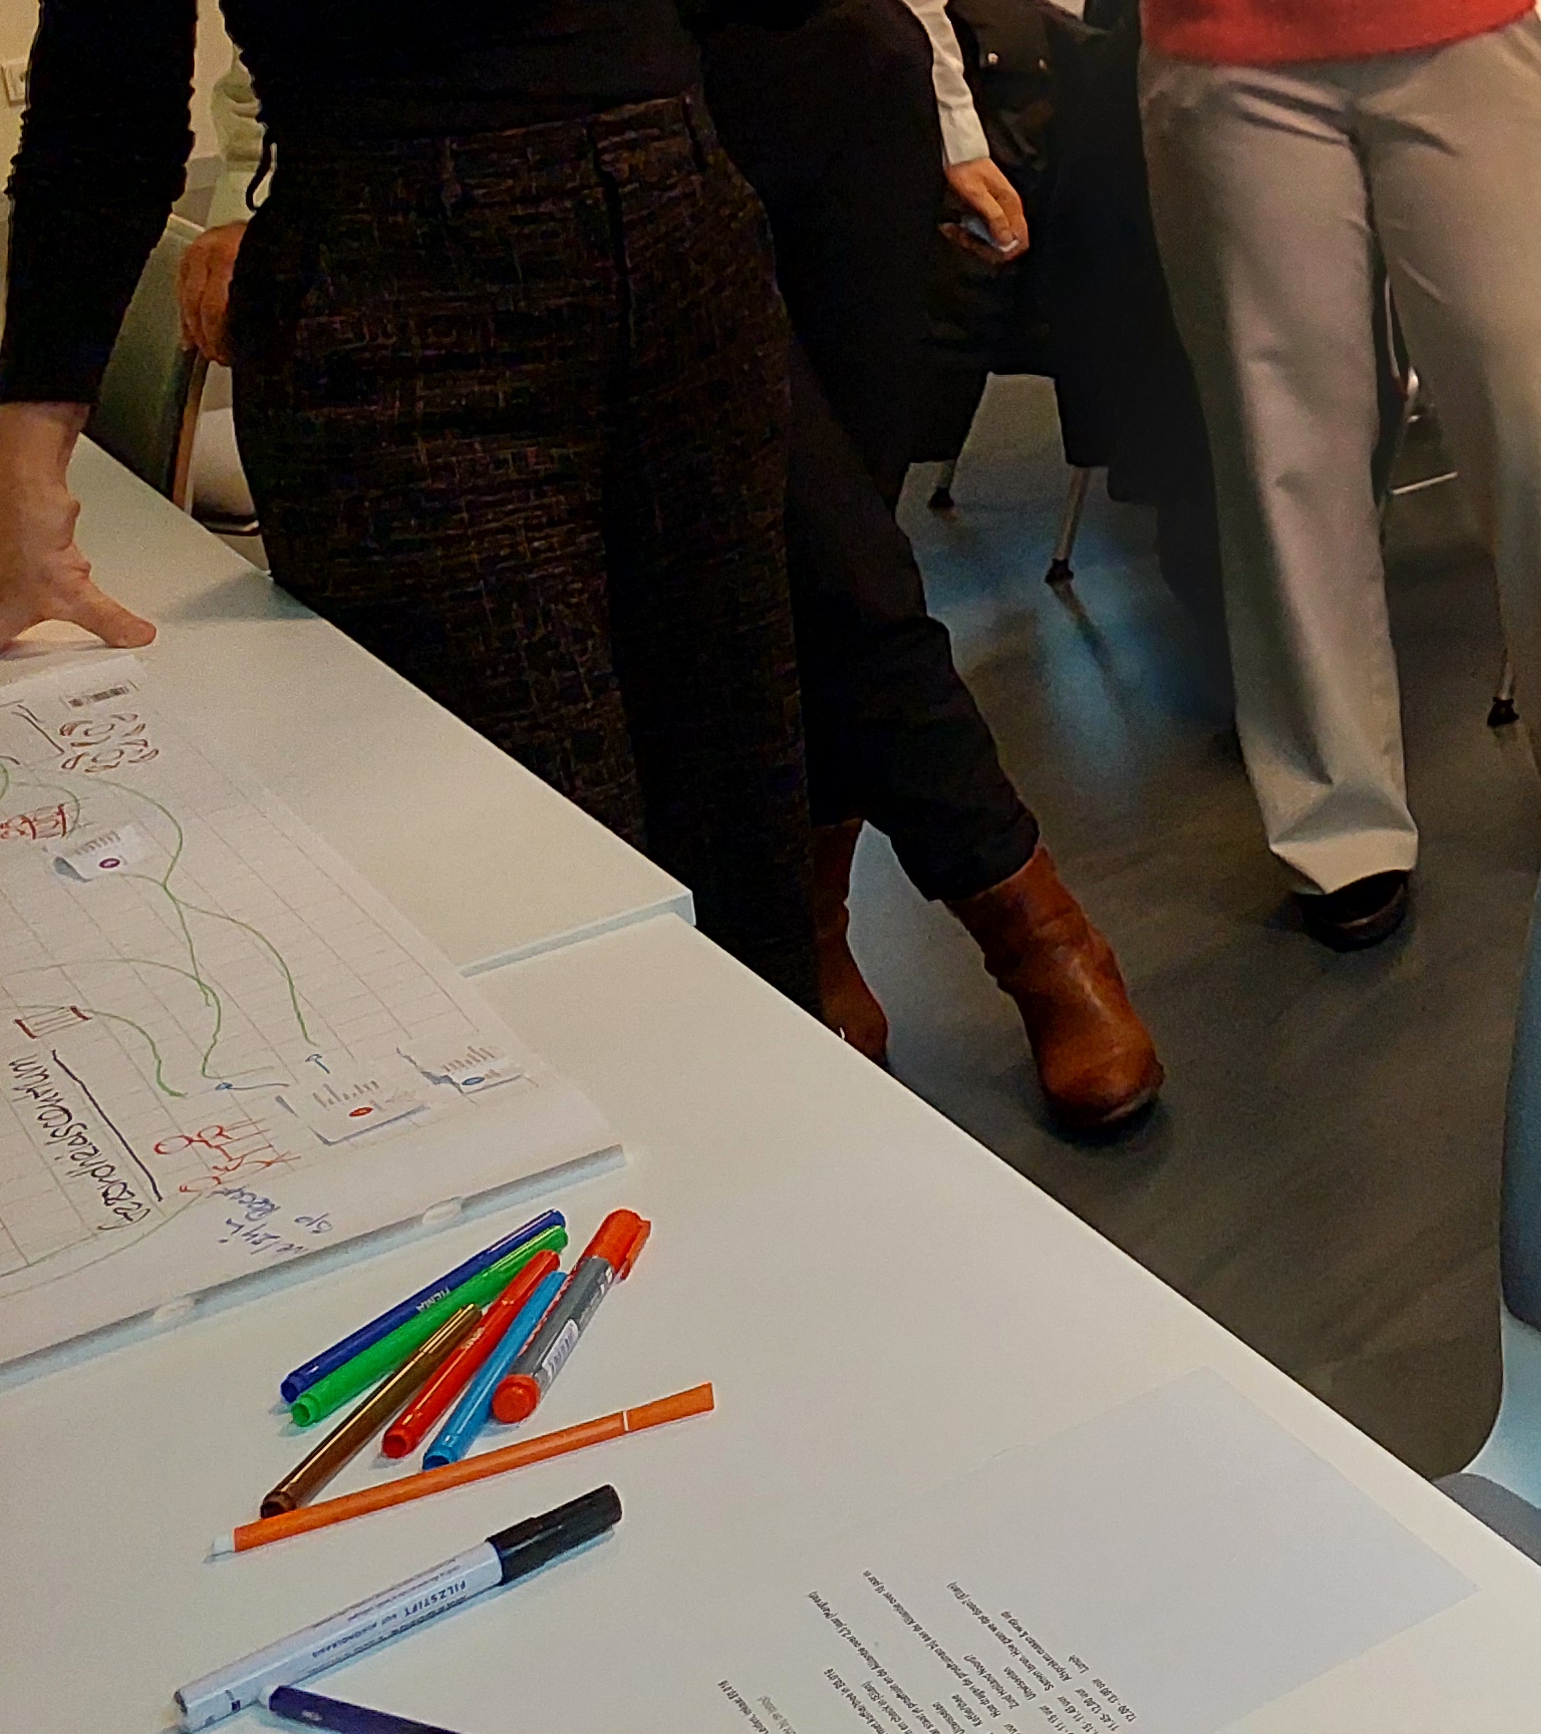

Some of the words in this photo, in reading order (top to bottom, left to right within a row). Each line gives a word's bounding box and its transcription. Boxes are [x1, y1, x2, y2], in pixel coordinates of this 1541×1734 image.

[404, 1580, 466, 1616] FILZSTIFT
[1068, 1655, 1089, 1674] Lunch
[1032, 1671, 1054, 1691] Samen
